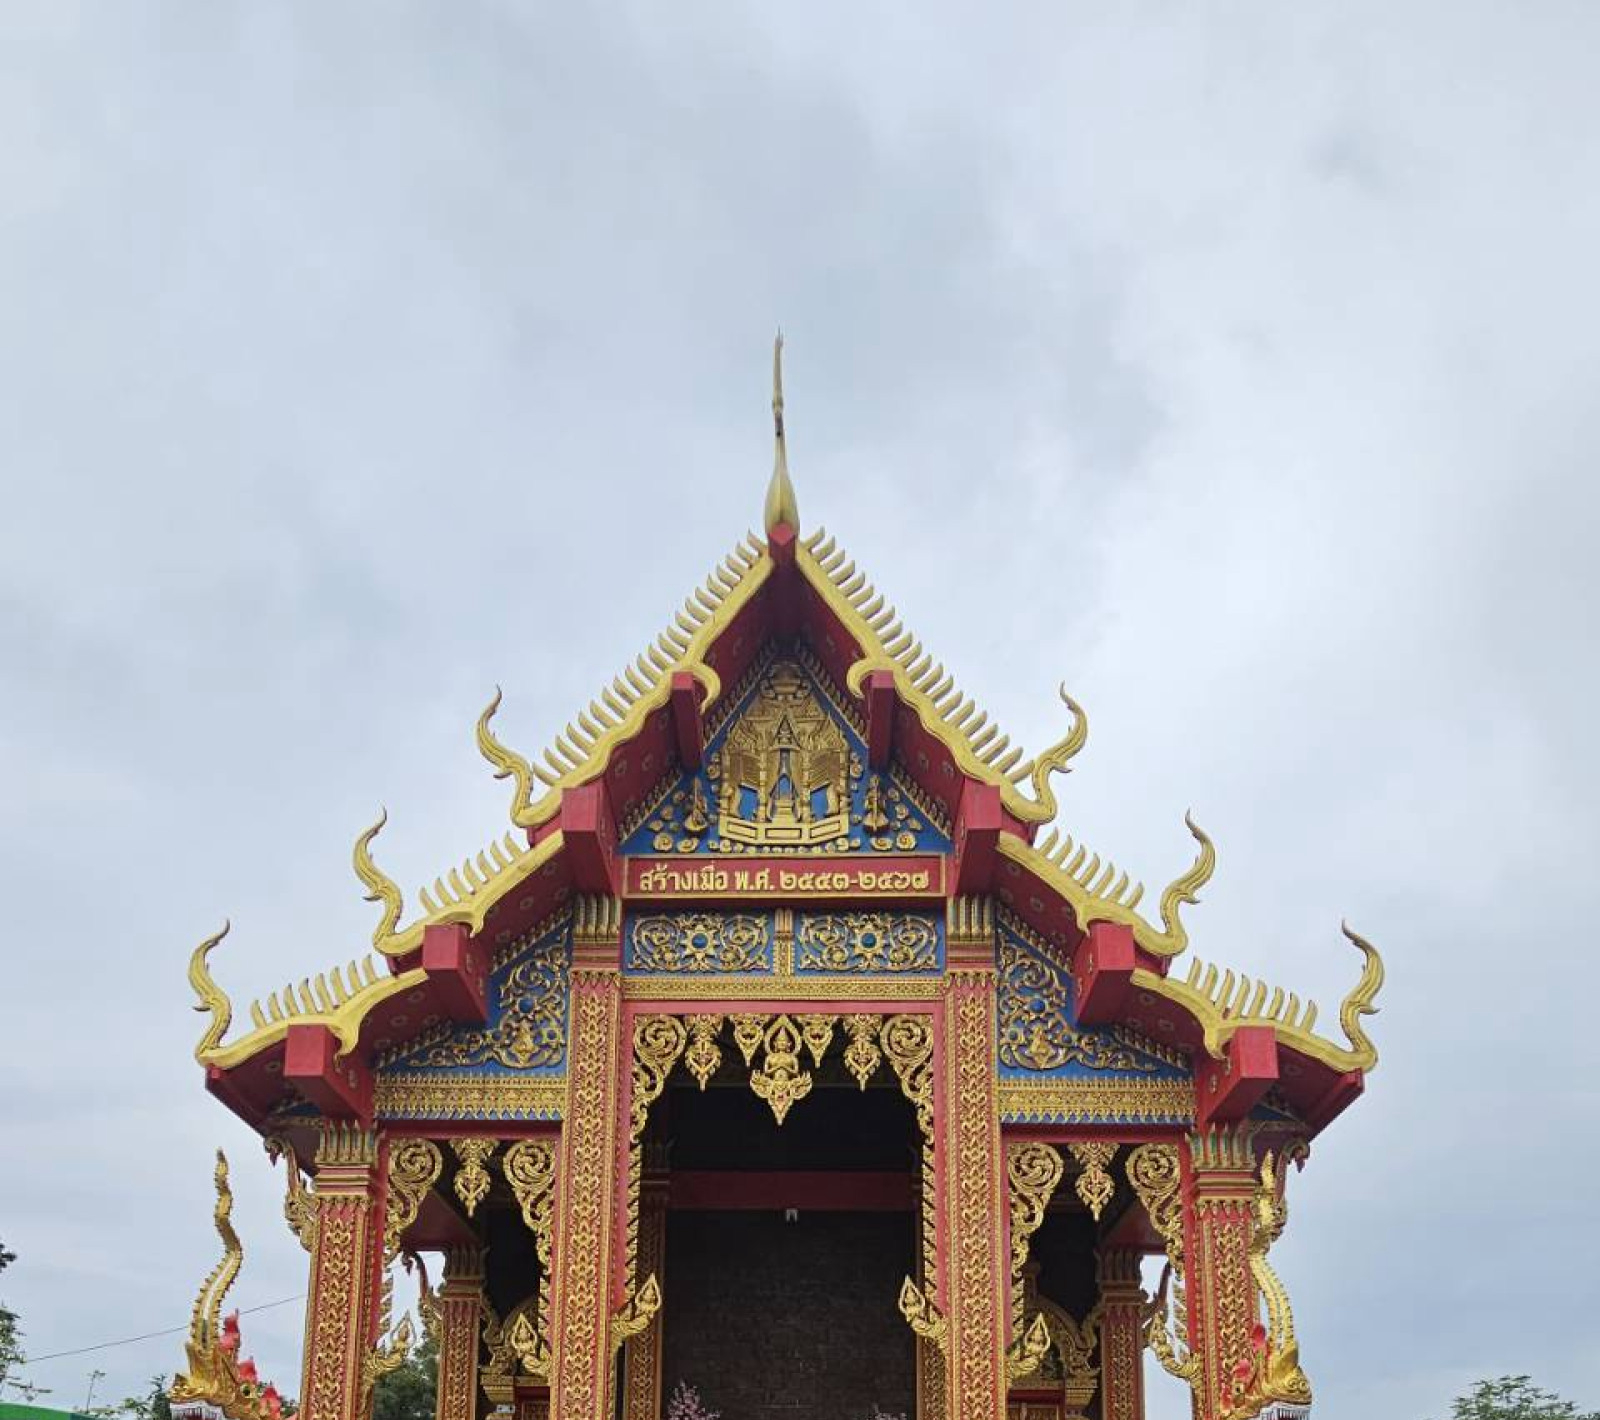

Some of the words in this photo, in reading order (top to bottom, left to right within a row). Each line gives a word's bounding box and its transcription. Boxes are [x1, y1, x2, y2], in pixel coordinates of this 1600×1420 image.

[639, 860, 728, 891] สร้างเมื่อ
[735, 867, 775, 891] พ.ศ.
